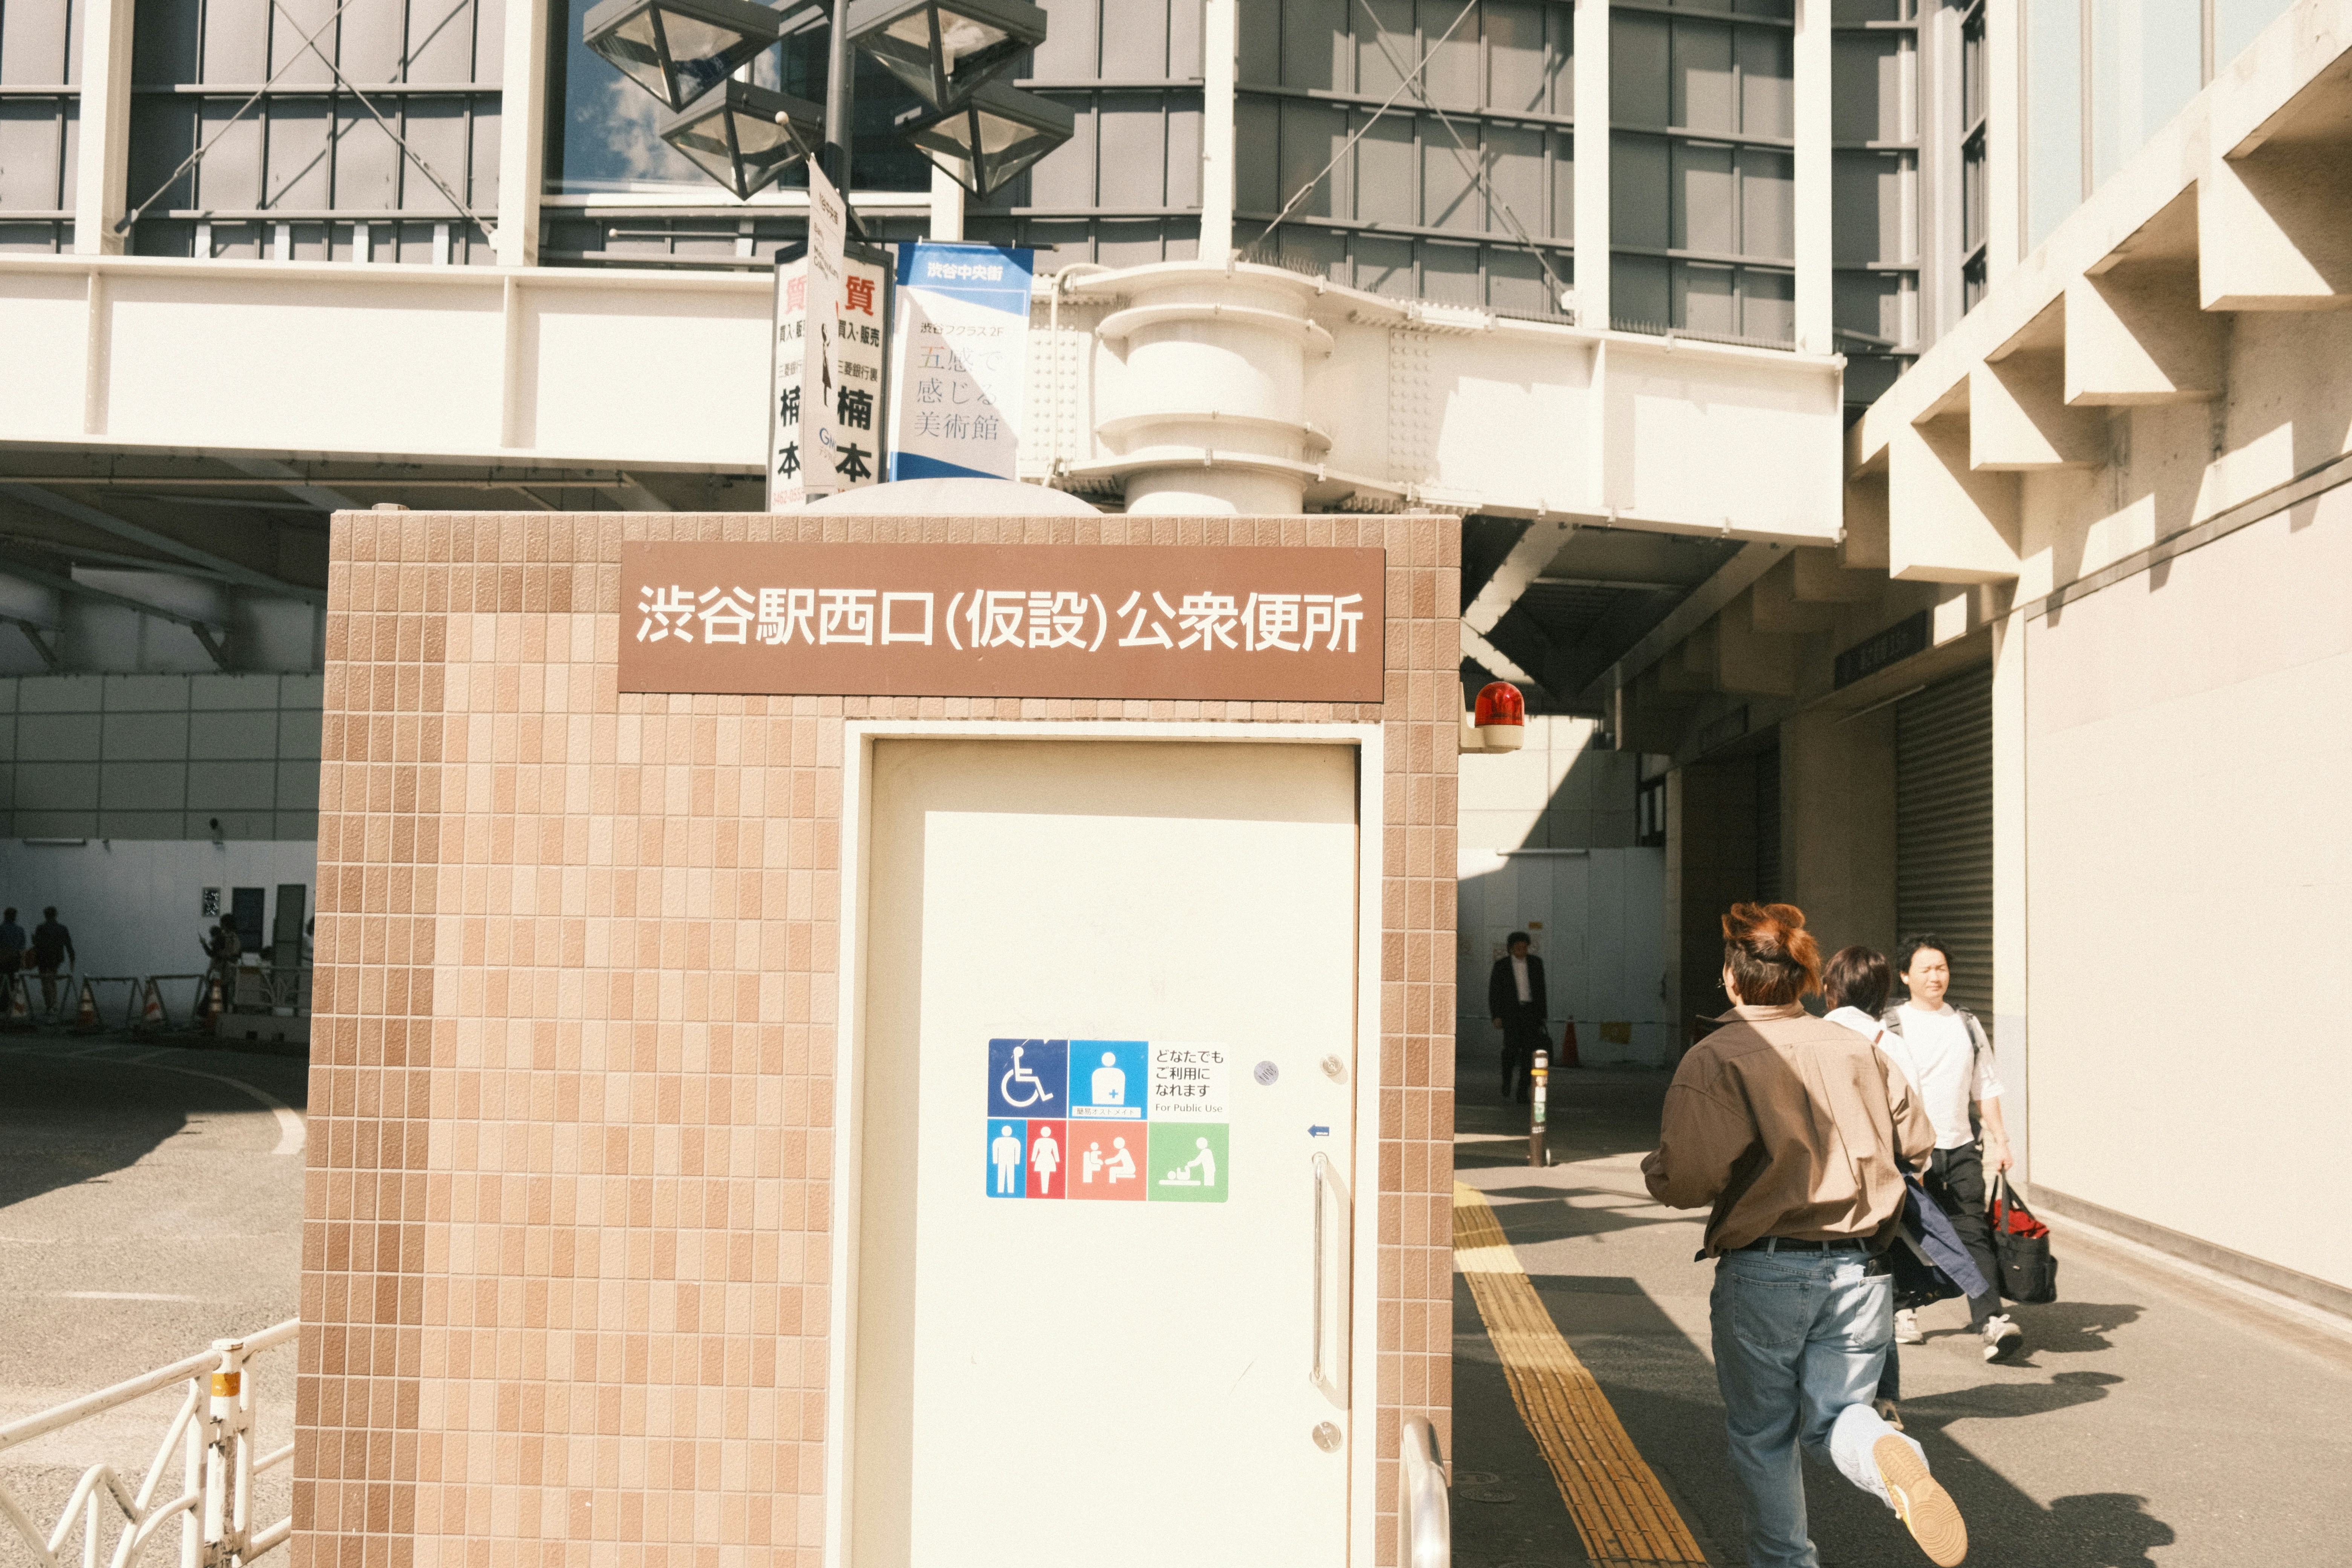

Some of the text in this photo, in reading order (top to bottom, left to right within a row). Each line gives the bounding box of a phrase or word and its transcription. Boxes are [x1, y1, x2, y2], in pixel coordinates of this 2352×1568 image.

[927, 261, 1003, 281] 渋谷中央街
[845, 275, 875, 316] 質
[920, 322, 1004, 337] 渋谷フクラス 2F
[917, 345, 1004, 373] 五感で
[838, 359, 877, 382] 三菱銀行裏
[917, 377, 997, 405] 感じる
[914, 411, 1000, 441] 美術館
[1157, 1049, 1224, 1063] どなたでも
[1156, 1066, 1210, 1080] ご利用に
[1156, 1083, 1210, 1097] なれます
